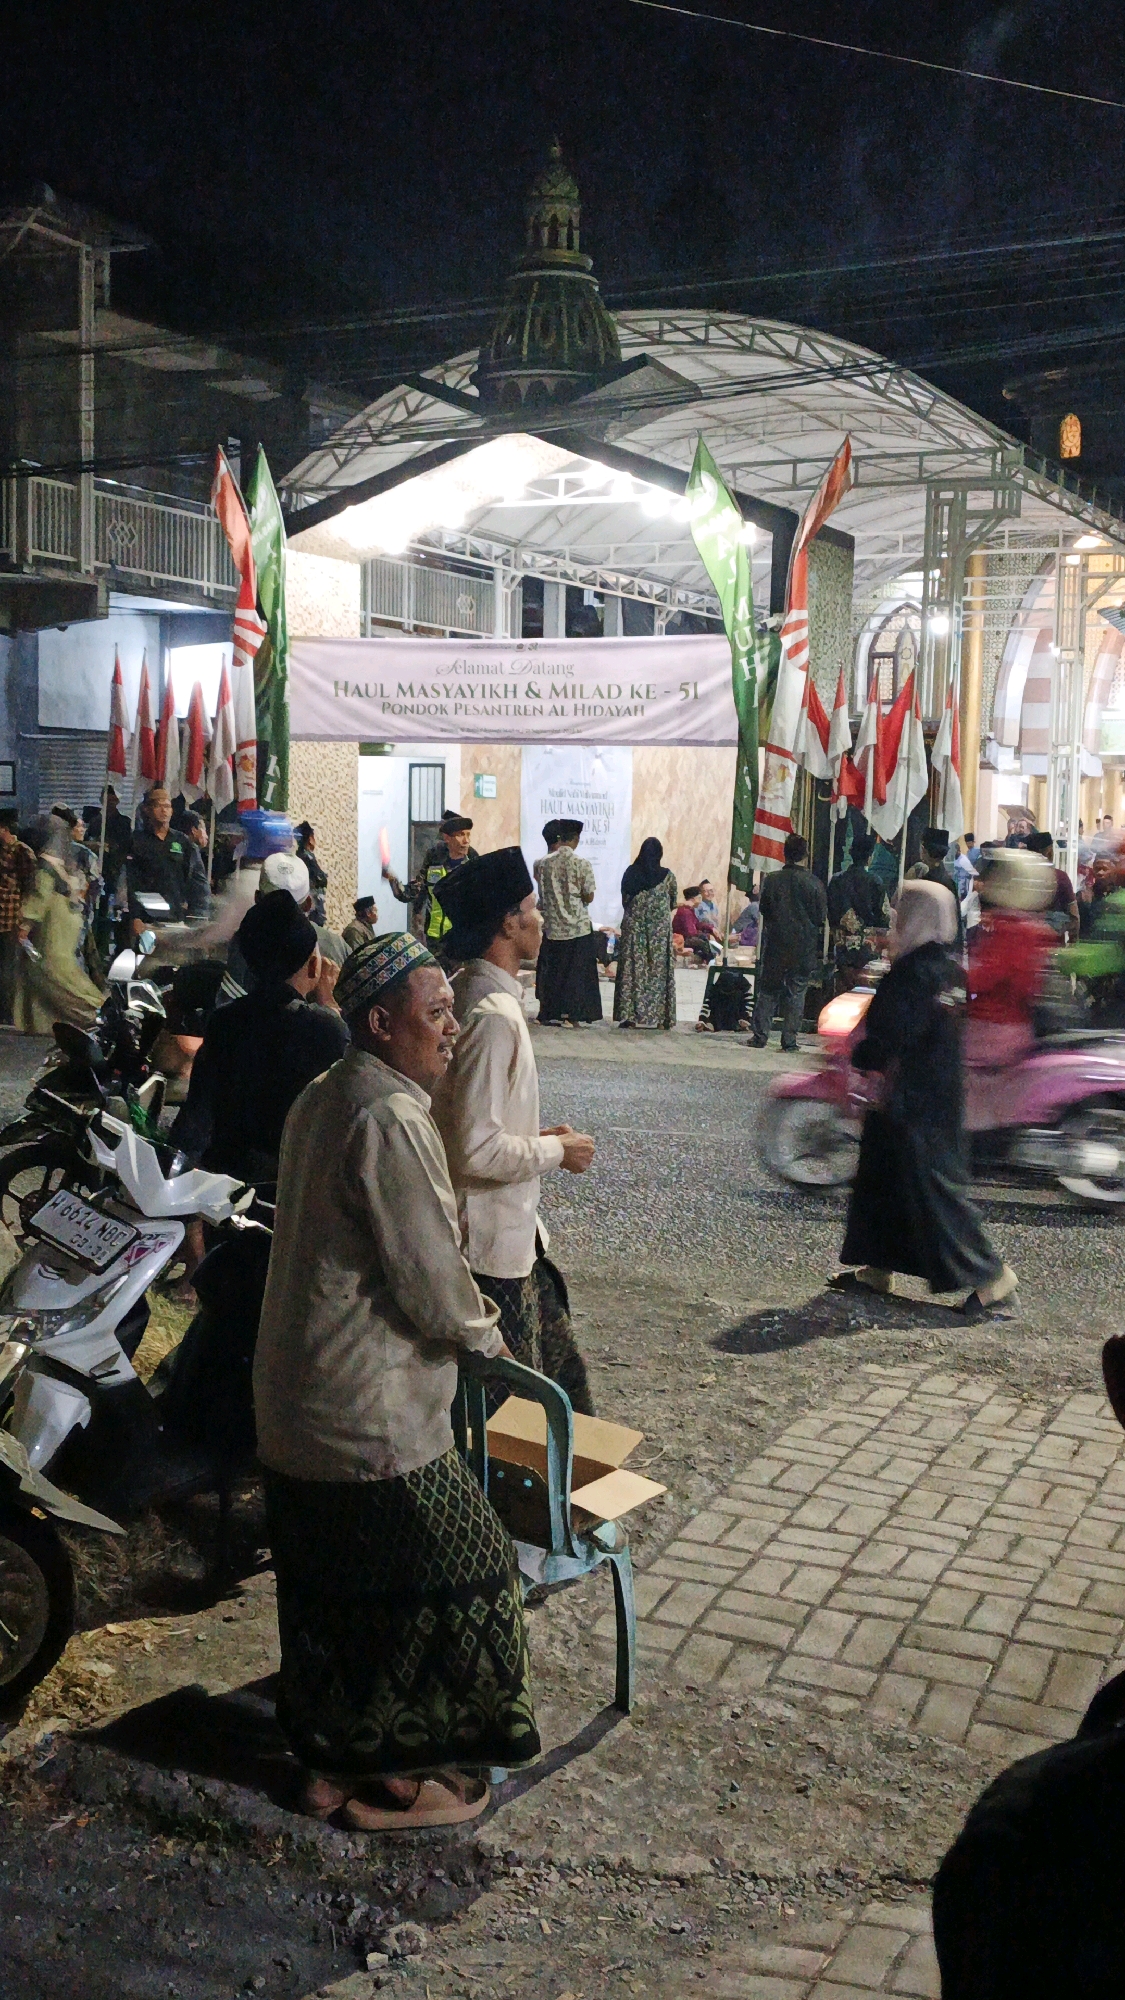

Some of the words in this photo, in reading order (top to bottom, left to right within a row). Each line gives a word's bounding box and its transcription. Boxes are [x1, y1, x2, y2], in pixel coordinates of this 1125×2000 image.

[435, 658, 505, 677] Selamat
[509, 657, 575, 679] Datang
[333, 680, 390, 699] HAUL
[396, 681, 518, 699] MASYAYIKH
[524, 680, 542, 699] &
[548, 681, 622, 700] MILAD
[630, 683, 657, 700] KE
[679, 681, 700, 701] 51
[381, 701, 448, 716] PONDOK
[454, 702, 544, 717] PESANTREN
[548, 704, 569, 717] AL
[573, 703, 645, 717] HIDAYAH
[540, 799, 564, 815] HAUL
